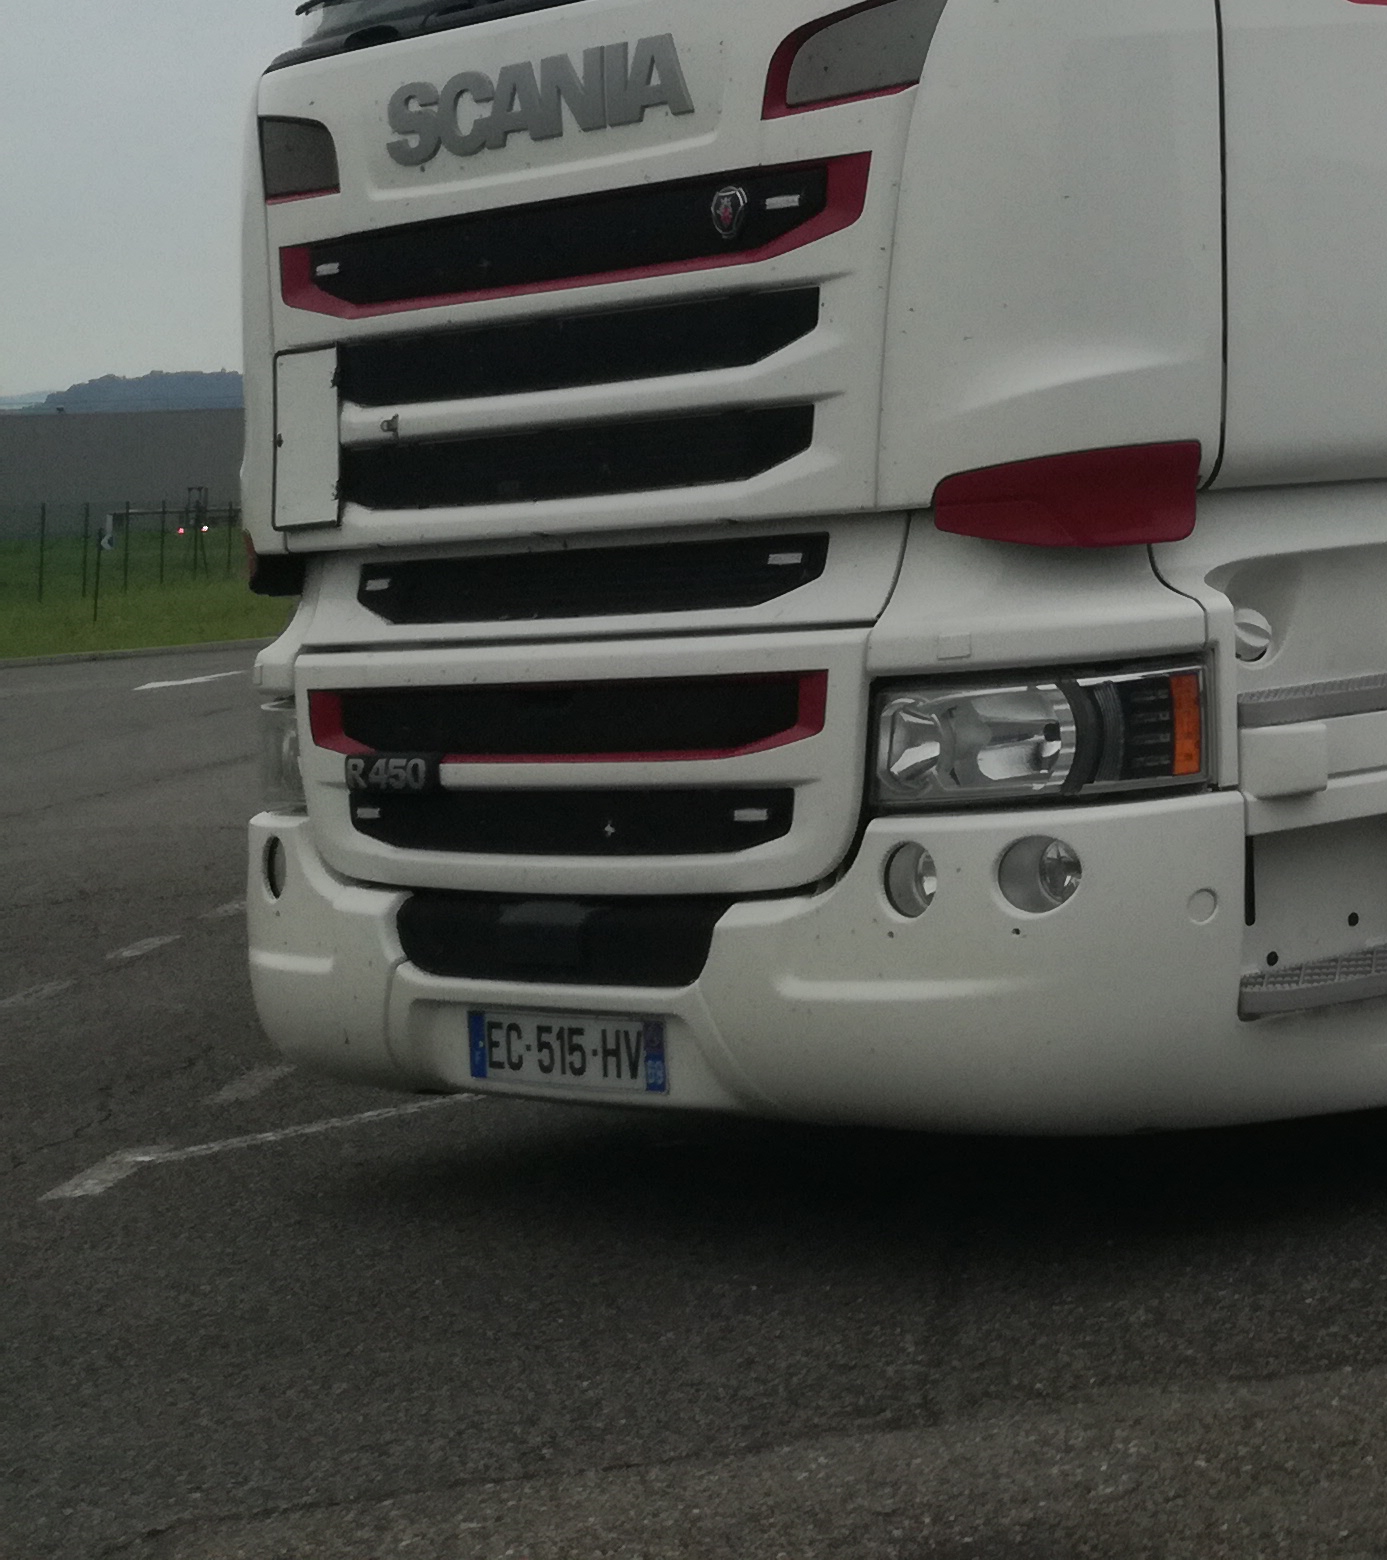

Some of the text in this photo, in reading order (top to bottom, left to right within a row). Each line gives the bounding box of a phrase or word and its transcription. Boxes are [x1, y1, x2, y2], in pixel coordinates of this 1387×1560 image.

[386, 32, 695, 167] SCANIA
[347, 757, 427, 790] R 450
